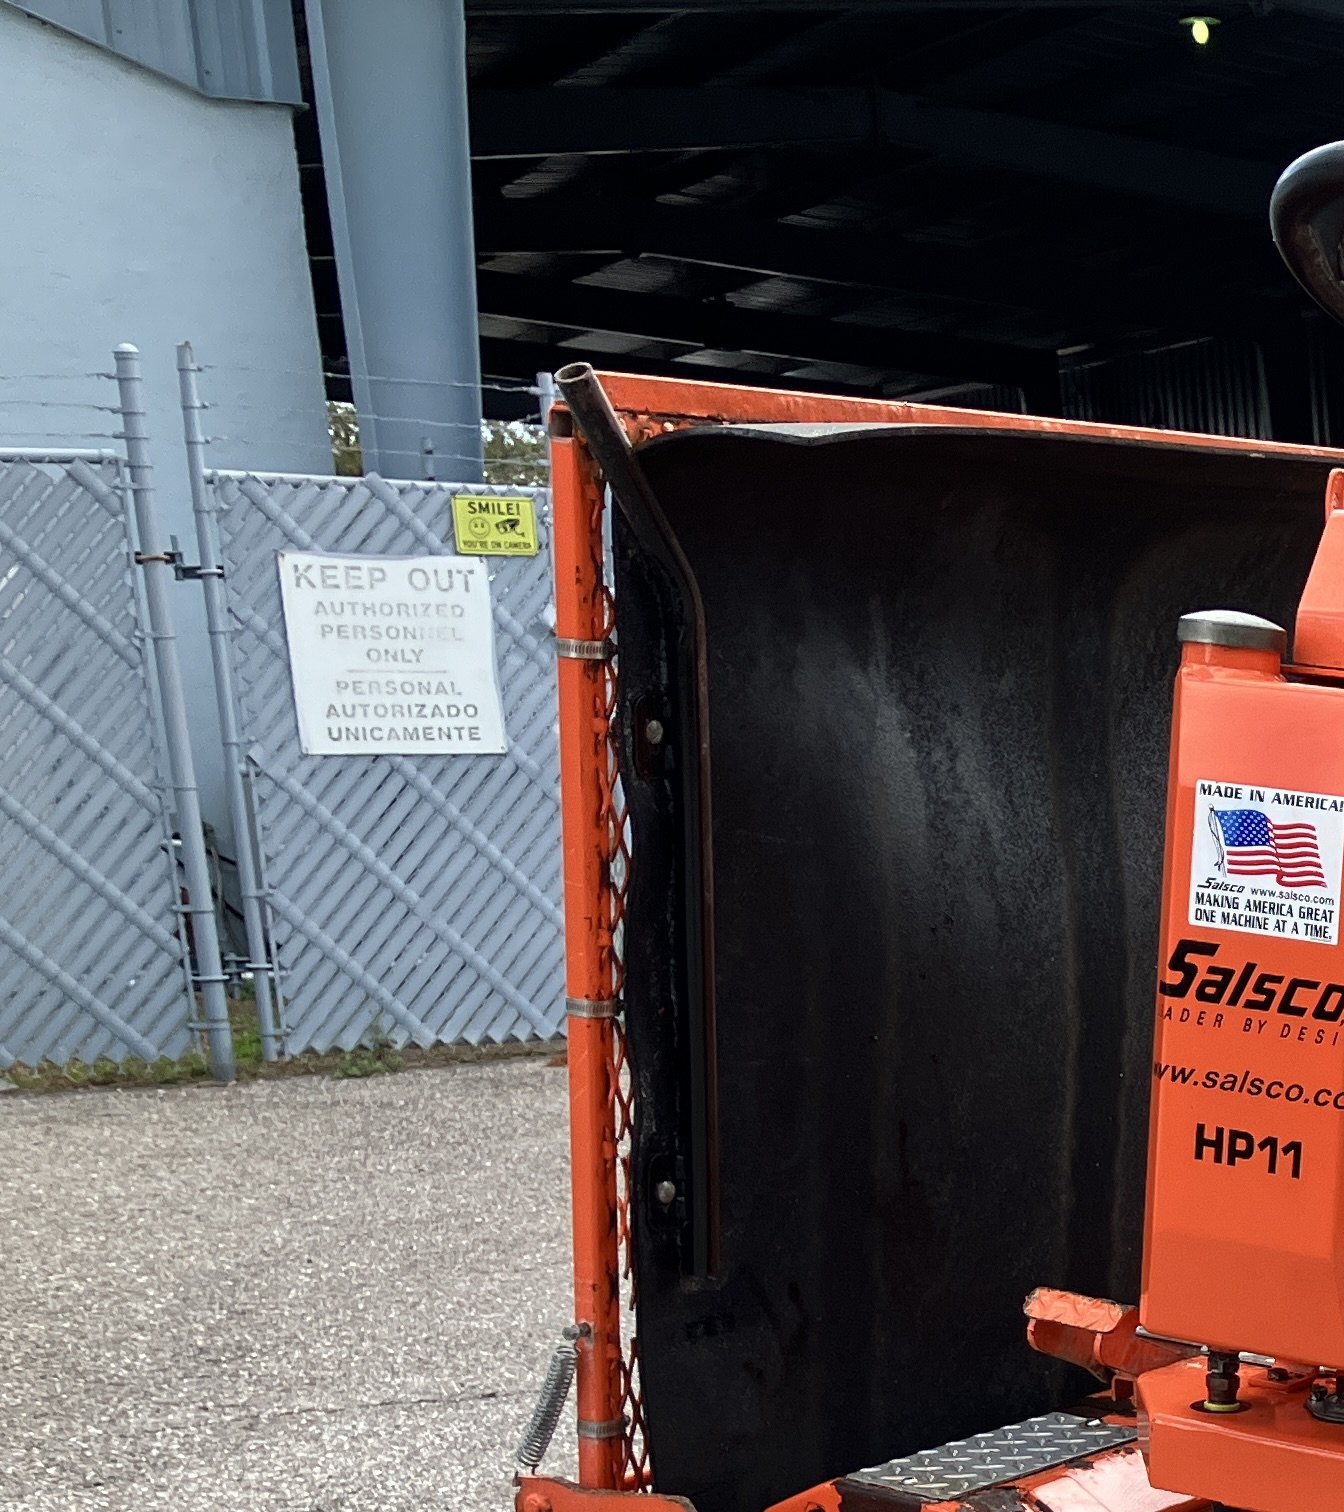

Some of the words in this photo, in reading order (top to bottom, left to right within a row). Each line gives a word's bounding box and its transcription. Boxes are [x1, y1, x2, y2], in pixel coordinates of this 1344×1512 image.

[468, 501, 520, 516] SMILE!
[293, 563, 387, 591] KEEP
[407, 567, 475, 594] OUT
[313, 600, 465, 618] AUTHORIZED
[366, 648, 424, 664] ONLY
[336, 680, 463, 696] PERSONAL
[326, 703, 478, 719] AUTORIZADO
[327, 726, 483, 742] UNICAMENTE
[1199, 783, 1243, 800] MADE
[1249, 789, 1266, 802] IN
[1271, 793, 1344, 813] AMERICA!
[1197, 876, 1246, 894] Salsco
[1250, 886, 1335, 906] www.salsco.com
[1195, 891, 1240, 910] MAKING
[1244, 898, 1294, 918] AMERICA
[1298, 906, 1335, 924] GREAT
[1195, 907, 1217, 923] ONE
[1221, 912, 1269, 931] MACHINE
[1273, 919, 1288, 933] AT
[1291, 922, 1300, 935] A
[1304, 923, 1333, 940] TIME.
[1160, 1006, 1224, 1029] ADER
[1242, 1017, 1268, 1034] BY
[1193, 1122, 1304, 1180] HP11
